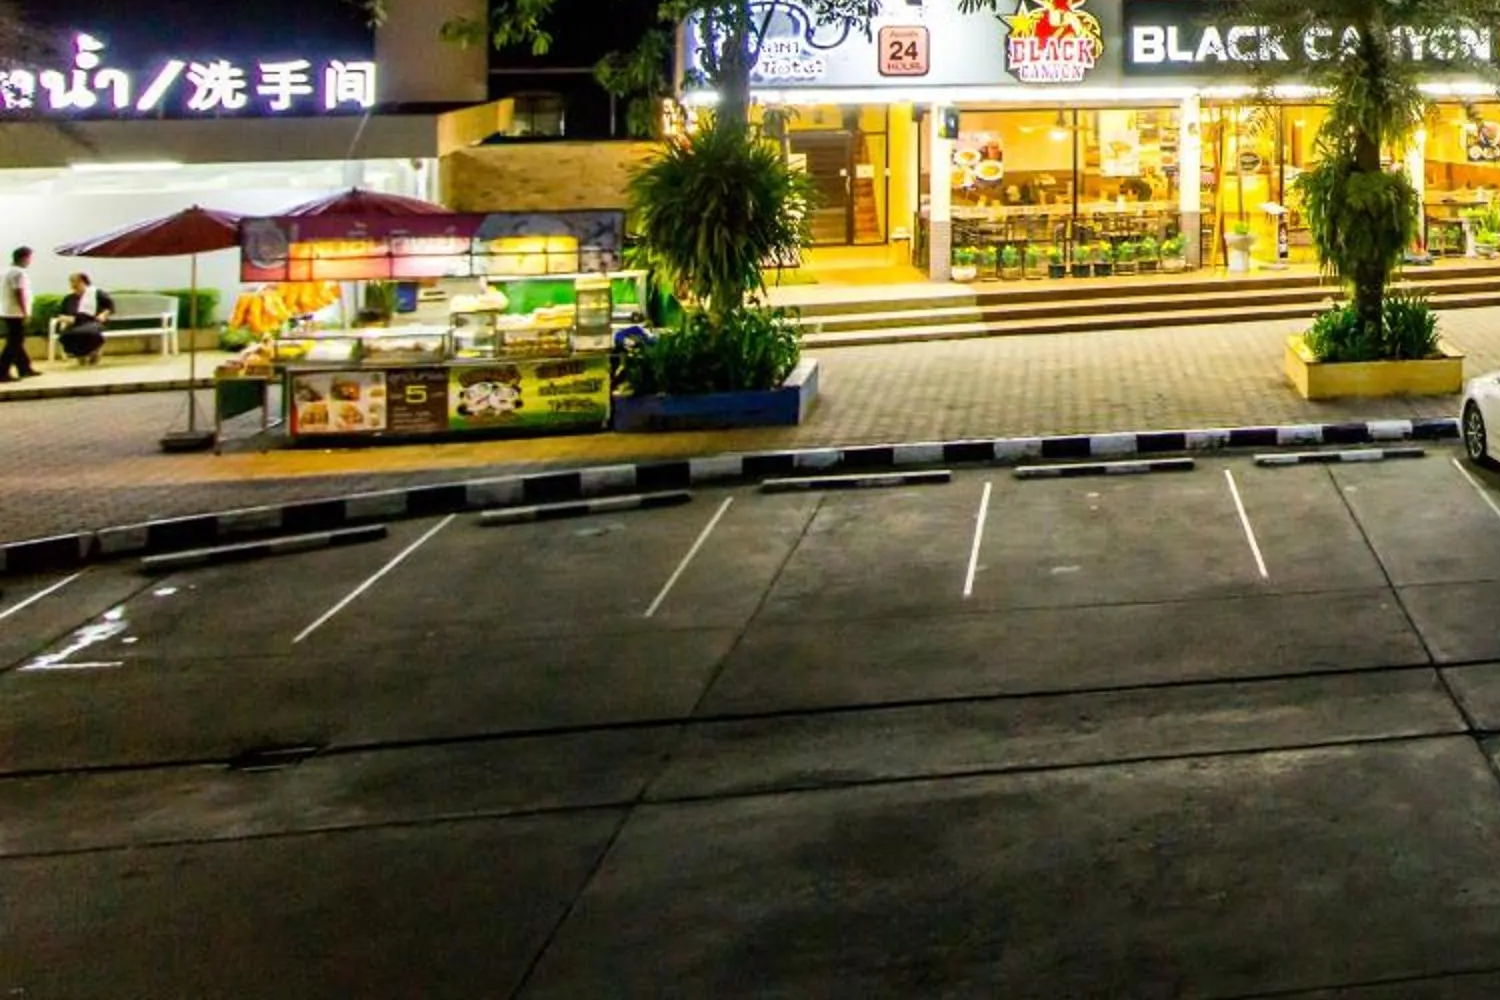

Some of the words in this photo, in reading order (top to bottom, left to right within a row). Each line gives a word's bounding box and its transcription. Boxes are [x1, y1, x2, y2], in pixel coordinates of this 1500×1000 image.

[890, 40, 919, 61] 24
[1011, 39, 1095, 64] BLACK
[1132, 25, 1291, 63] BLACK
[1302, 22, 1491, 62] CAYON
